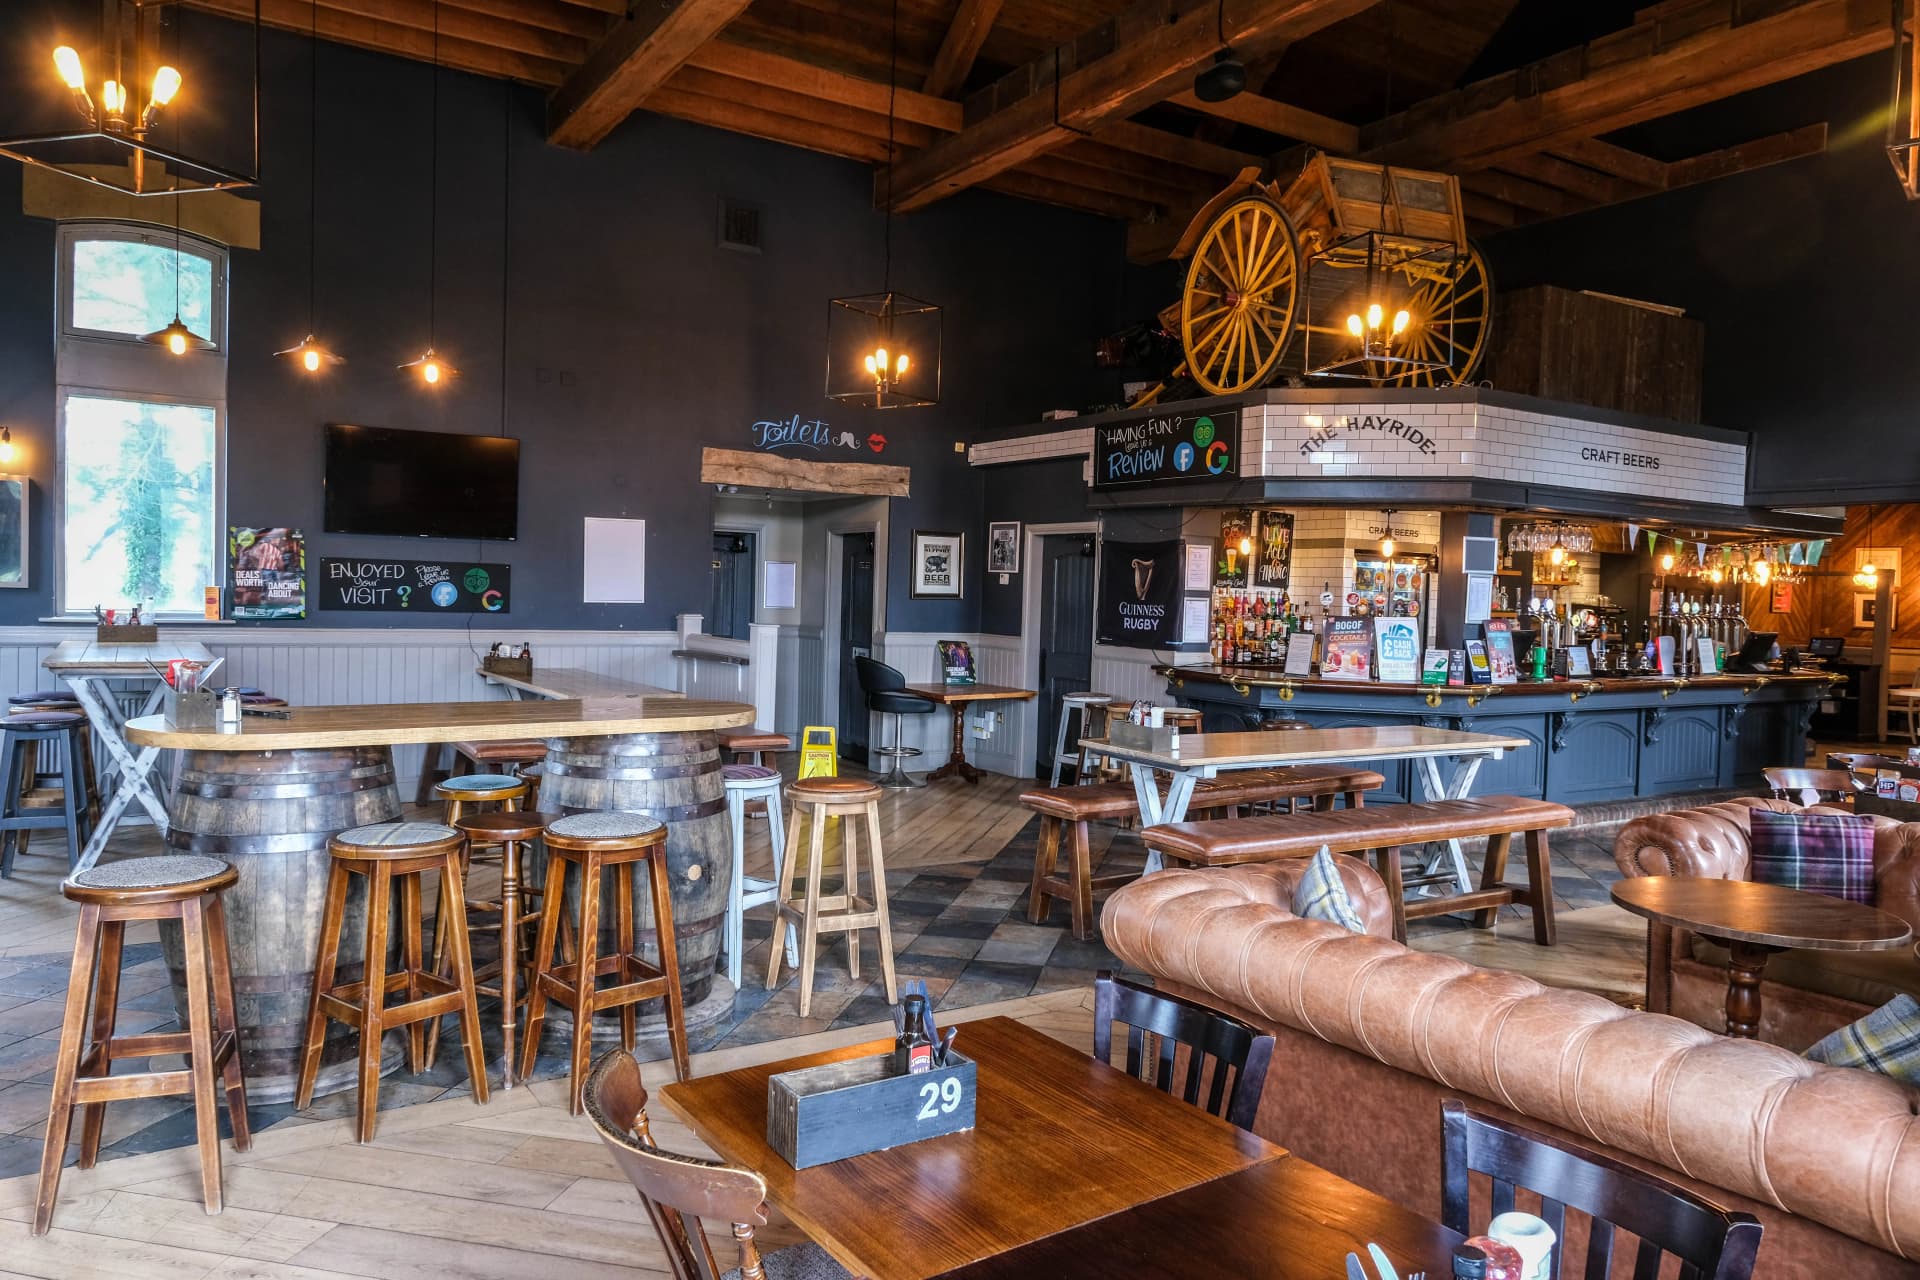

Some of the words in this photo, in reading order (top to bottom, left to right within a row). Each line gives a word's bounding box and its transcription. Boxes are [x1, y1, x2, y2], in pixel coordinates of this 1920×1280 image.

[752, 414, 830, 447] Toilets
[1106, 424, 1146, 446] HAVING
[1148, 418, 1173, 435] FUN
[1300, 424, 1339, 453] THE
[1346, 415, 1436, 455] HAYRIDE
[1107, 445, 1165, 479] Review
[1581, 447, 1621, 465] CRAFT
[1623, 453, 1660, 470] BEERS
[1368, 526, 1393, 535] CRA
[1394, 528, 1419, 538] BEERS
[236, 570, 260, 579] DEALS
[329, 562, 405, 579] ENJOYED
[236, 578, 263, 587] WORTH
[268, 582, 299, 590] DANCING
[268, 589, 292, 598] ABOUT
[340, 587, 392, 605] VISIT
[1118, 601, 1165, 617] GUINNESS
[1123, 617, 1159, 631] RUGBY
[1335, 620, 1362, 630] BOGOF
[1329, 634, 1367, 642] COCKTAILS
[1393, 639, 1411, 649] CASH
[1880, 781, 1894, 790] HP
[916, 1077, 962, 1120] 29
